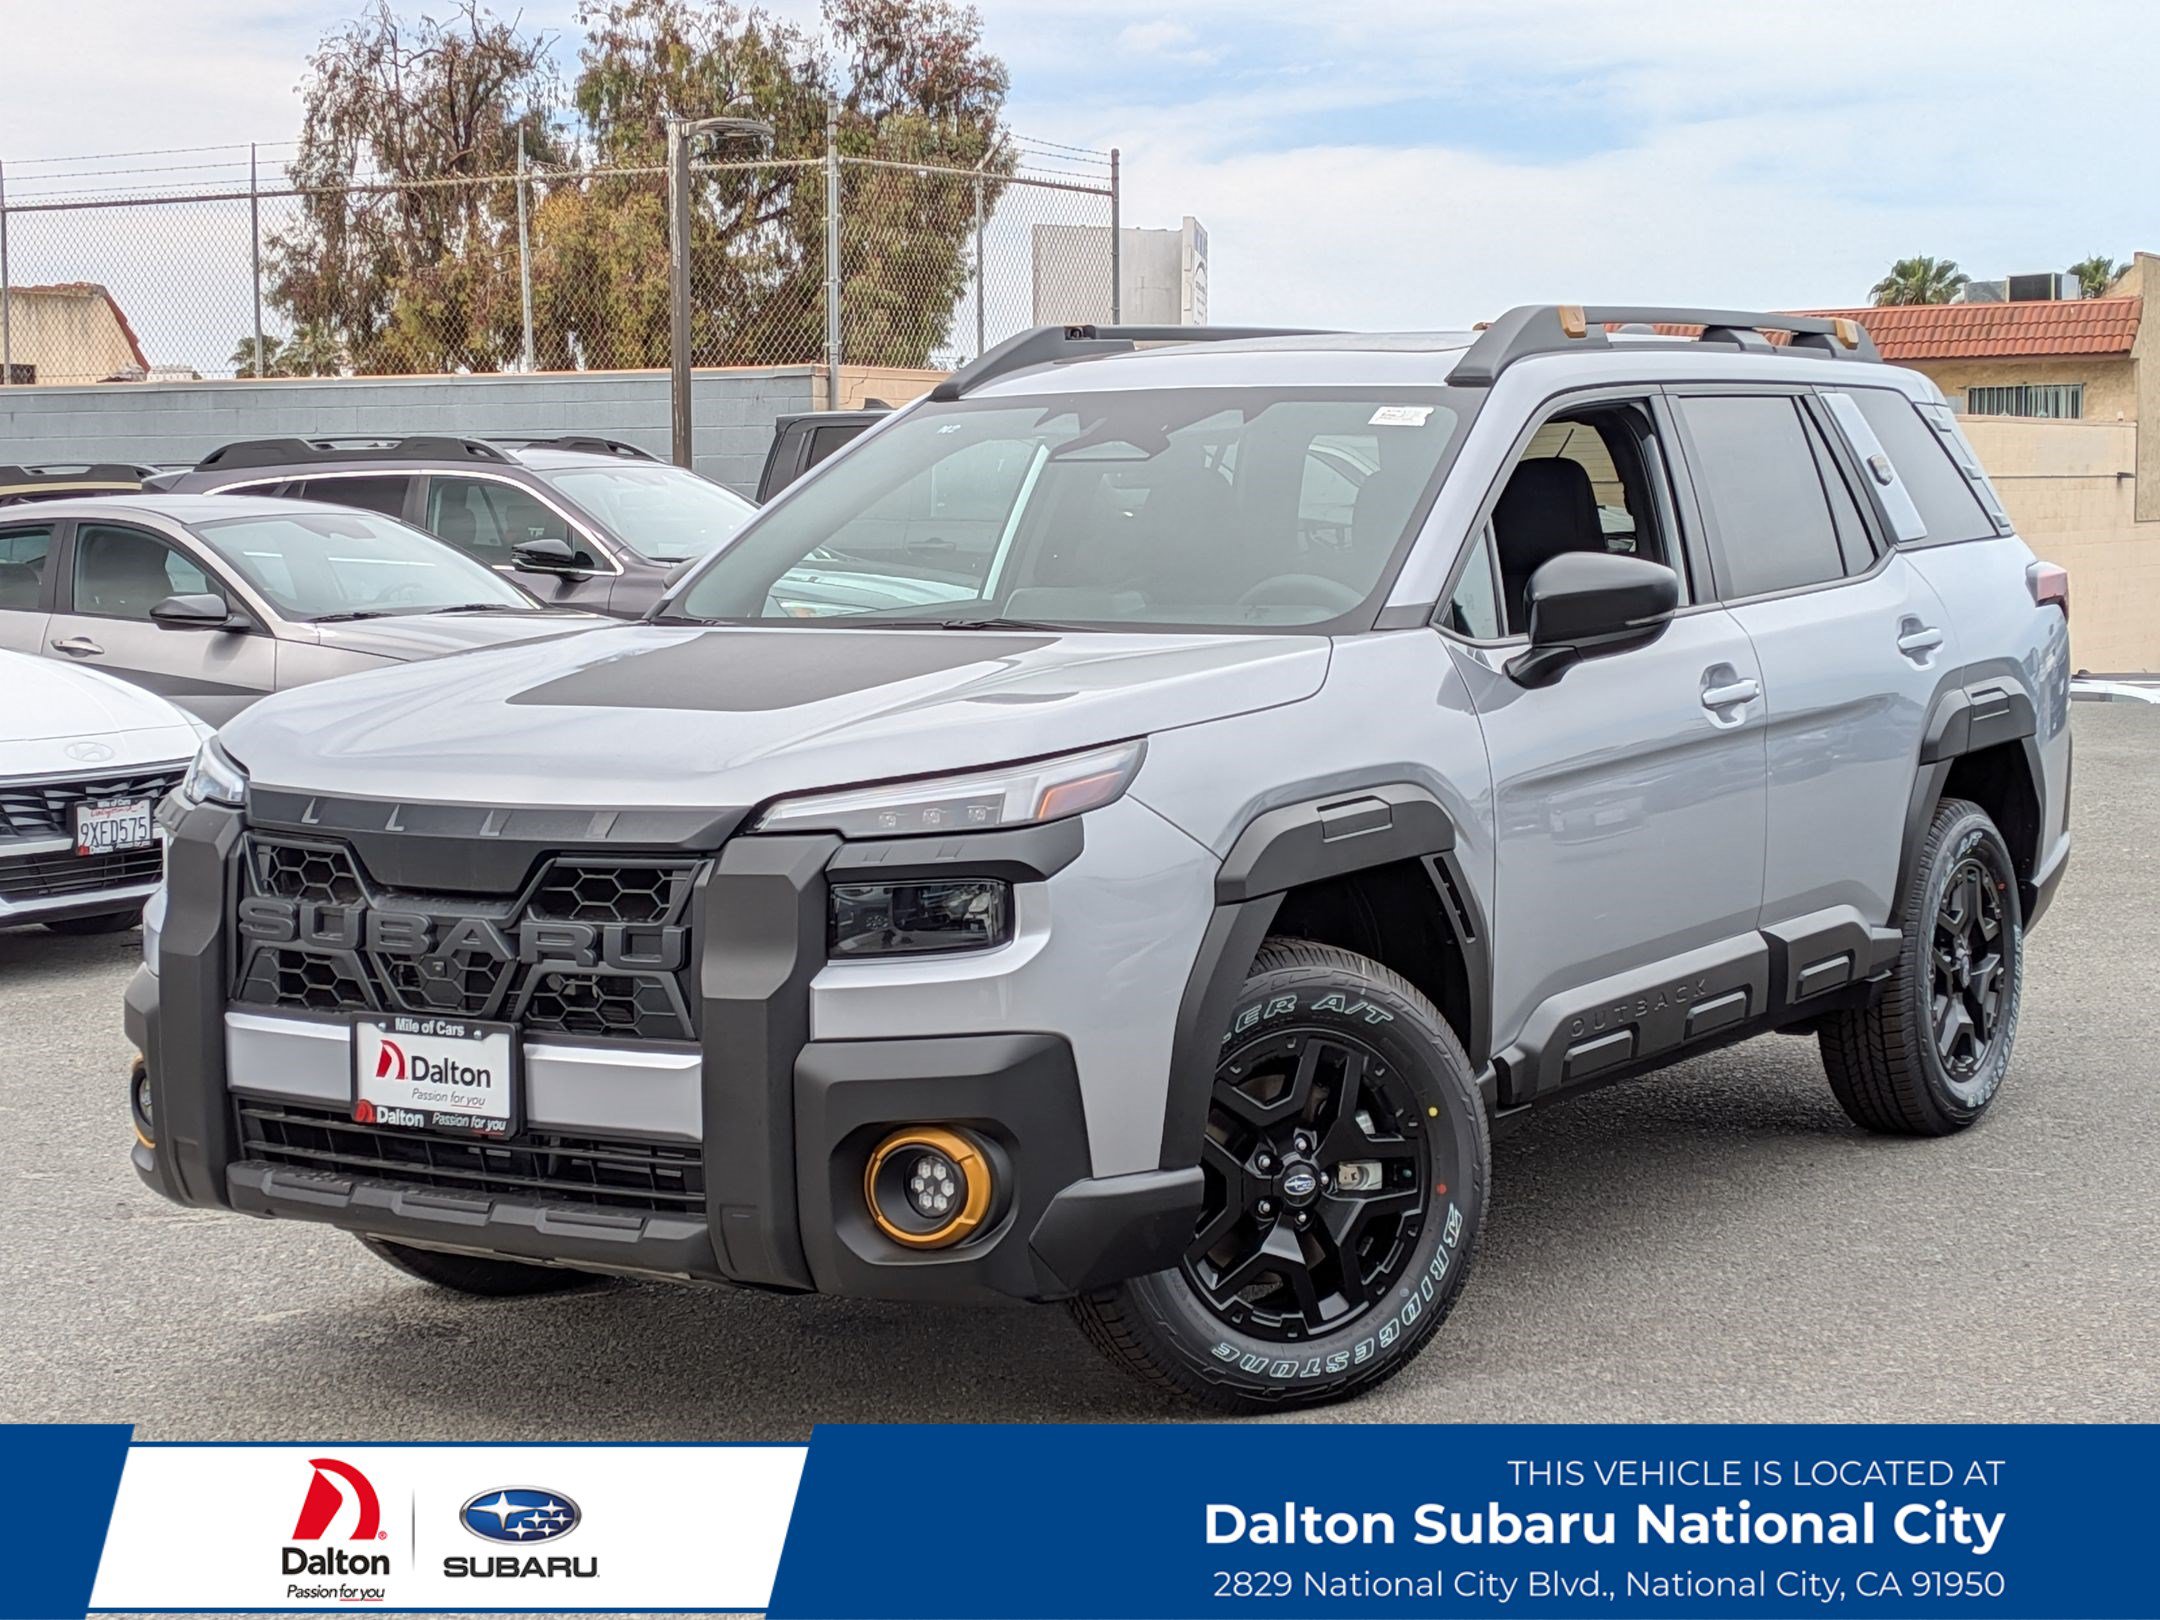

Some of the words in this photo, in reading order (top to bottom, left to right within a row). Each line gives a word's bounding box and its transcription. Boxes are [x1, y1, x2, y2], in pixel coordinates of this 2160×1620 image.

[238, 898, 692, 972] SUBARU
[395, 1017, 420, 1033] Mile
[421, 1020, 435, 1034] of
[436, 1021, 465, 1037] Cars
[1222, 994, 1298, 1044] ER
[1310, 994, 1395, 1025] A/T
[1569, 978, 1707, 1038] OUTBACK
[411, 1055, 492, 1089] Dalton
[411, 1087, 449, 1103] Passion
[449, 1091, 465, 1105] for
[465, 1095, 487, 1107] you
[376, 1106, 425, 1128] Dalton
[431, 1112, 470, 1128] Passion
[470, 1114, 487, 1130] for
[486, 1119, 507, 1132] you
[1211, 1203, 1463, 1379] BRIDGESTONE
